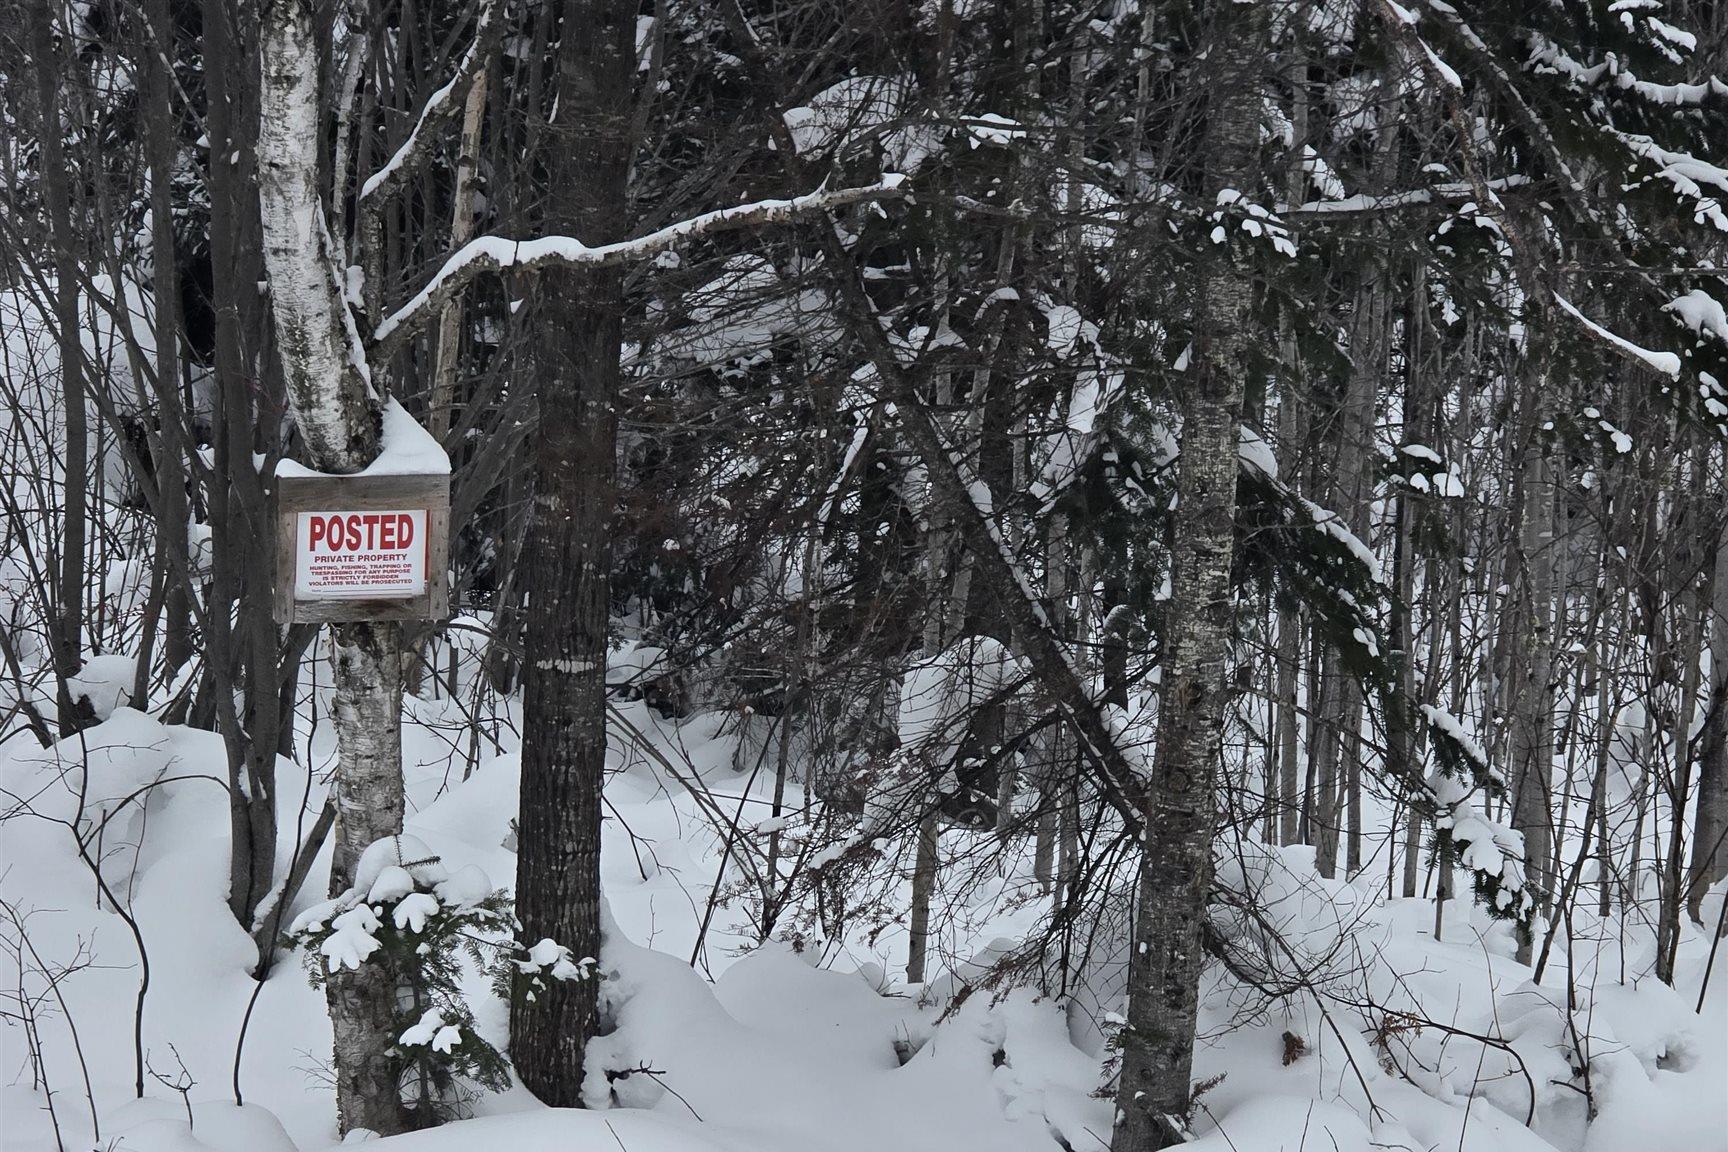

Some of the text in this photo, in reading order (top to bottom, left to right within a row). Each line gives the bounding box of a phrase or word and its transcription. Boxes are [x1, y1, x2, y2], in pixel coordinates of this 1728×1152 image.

[309, 514, 414, 552] POSTED
[314, 553, 408, 563] PRIVATE PROPERTY
